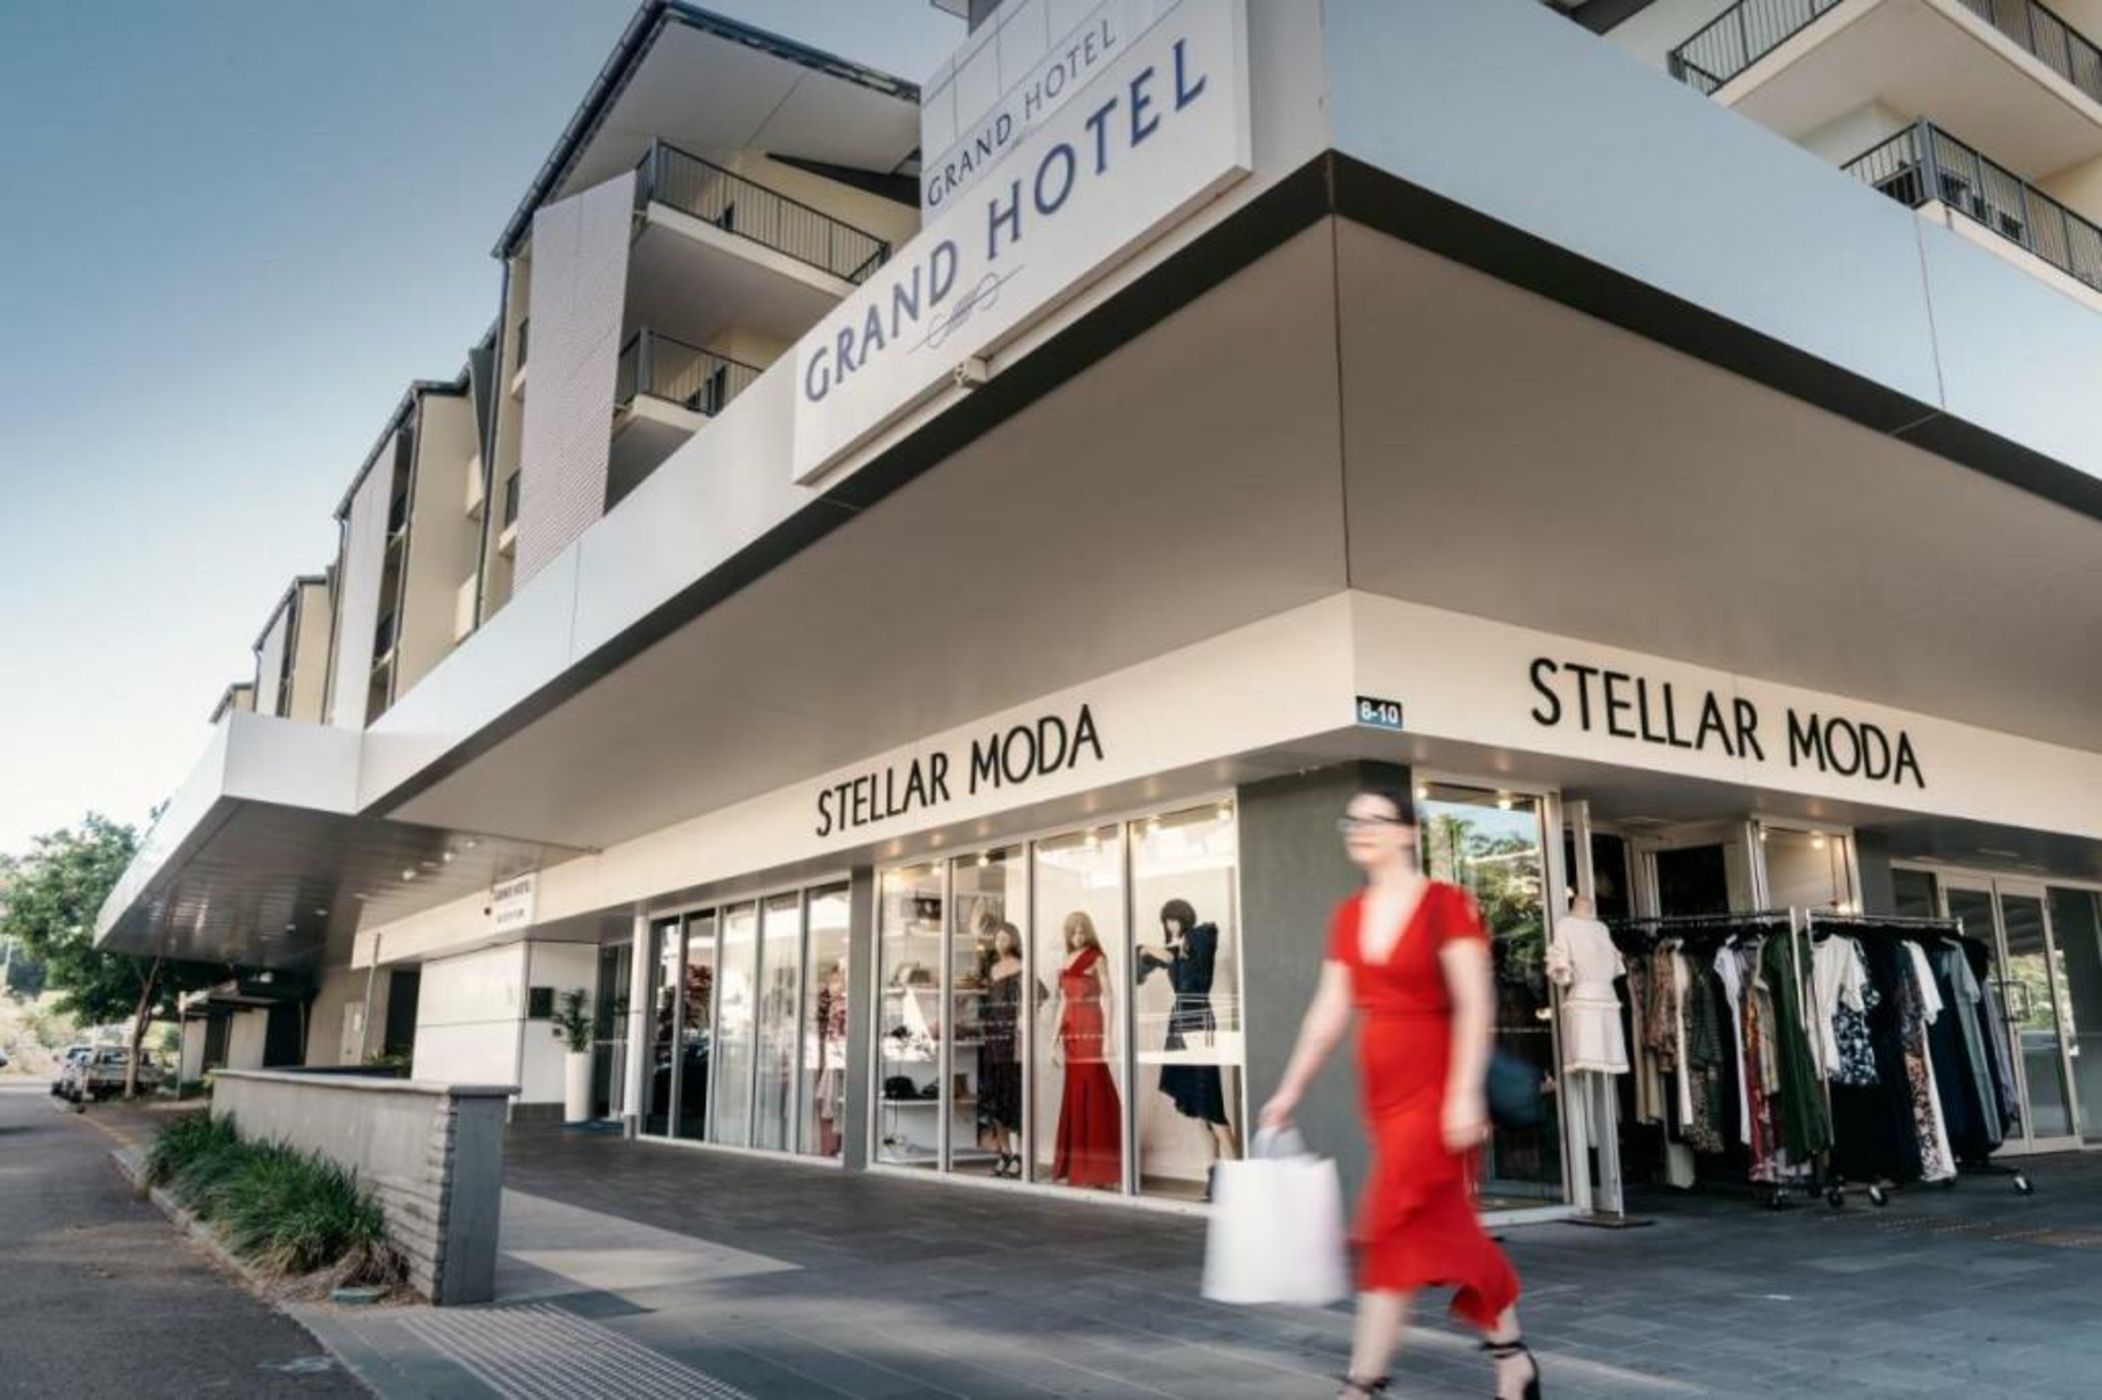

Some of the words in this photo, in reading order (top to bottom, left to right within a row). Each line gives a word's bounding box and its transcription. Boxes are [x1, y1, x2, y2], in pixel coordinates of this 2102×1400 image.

[927, 113, 1012, 207] GRAND
[1024, 19, 1117, 121] HOTEL
[804, 239, 959, 402] GRAND
[986, 37, 1207, 261] HOTEL
[816, 751, 951, 838] STELLAR
[968, 703, 1104, 796] MODA
[1360, 700, 1399, 724] 8-10
[1529, 656, 1765, 761] STELLAR
[1787, 707, 1926, 788] MODA
